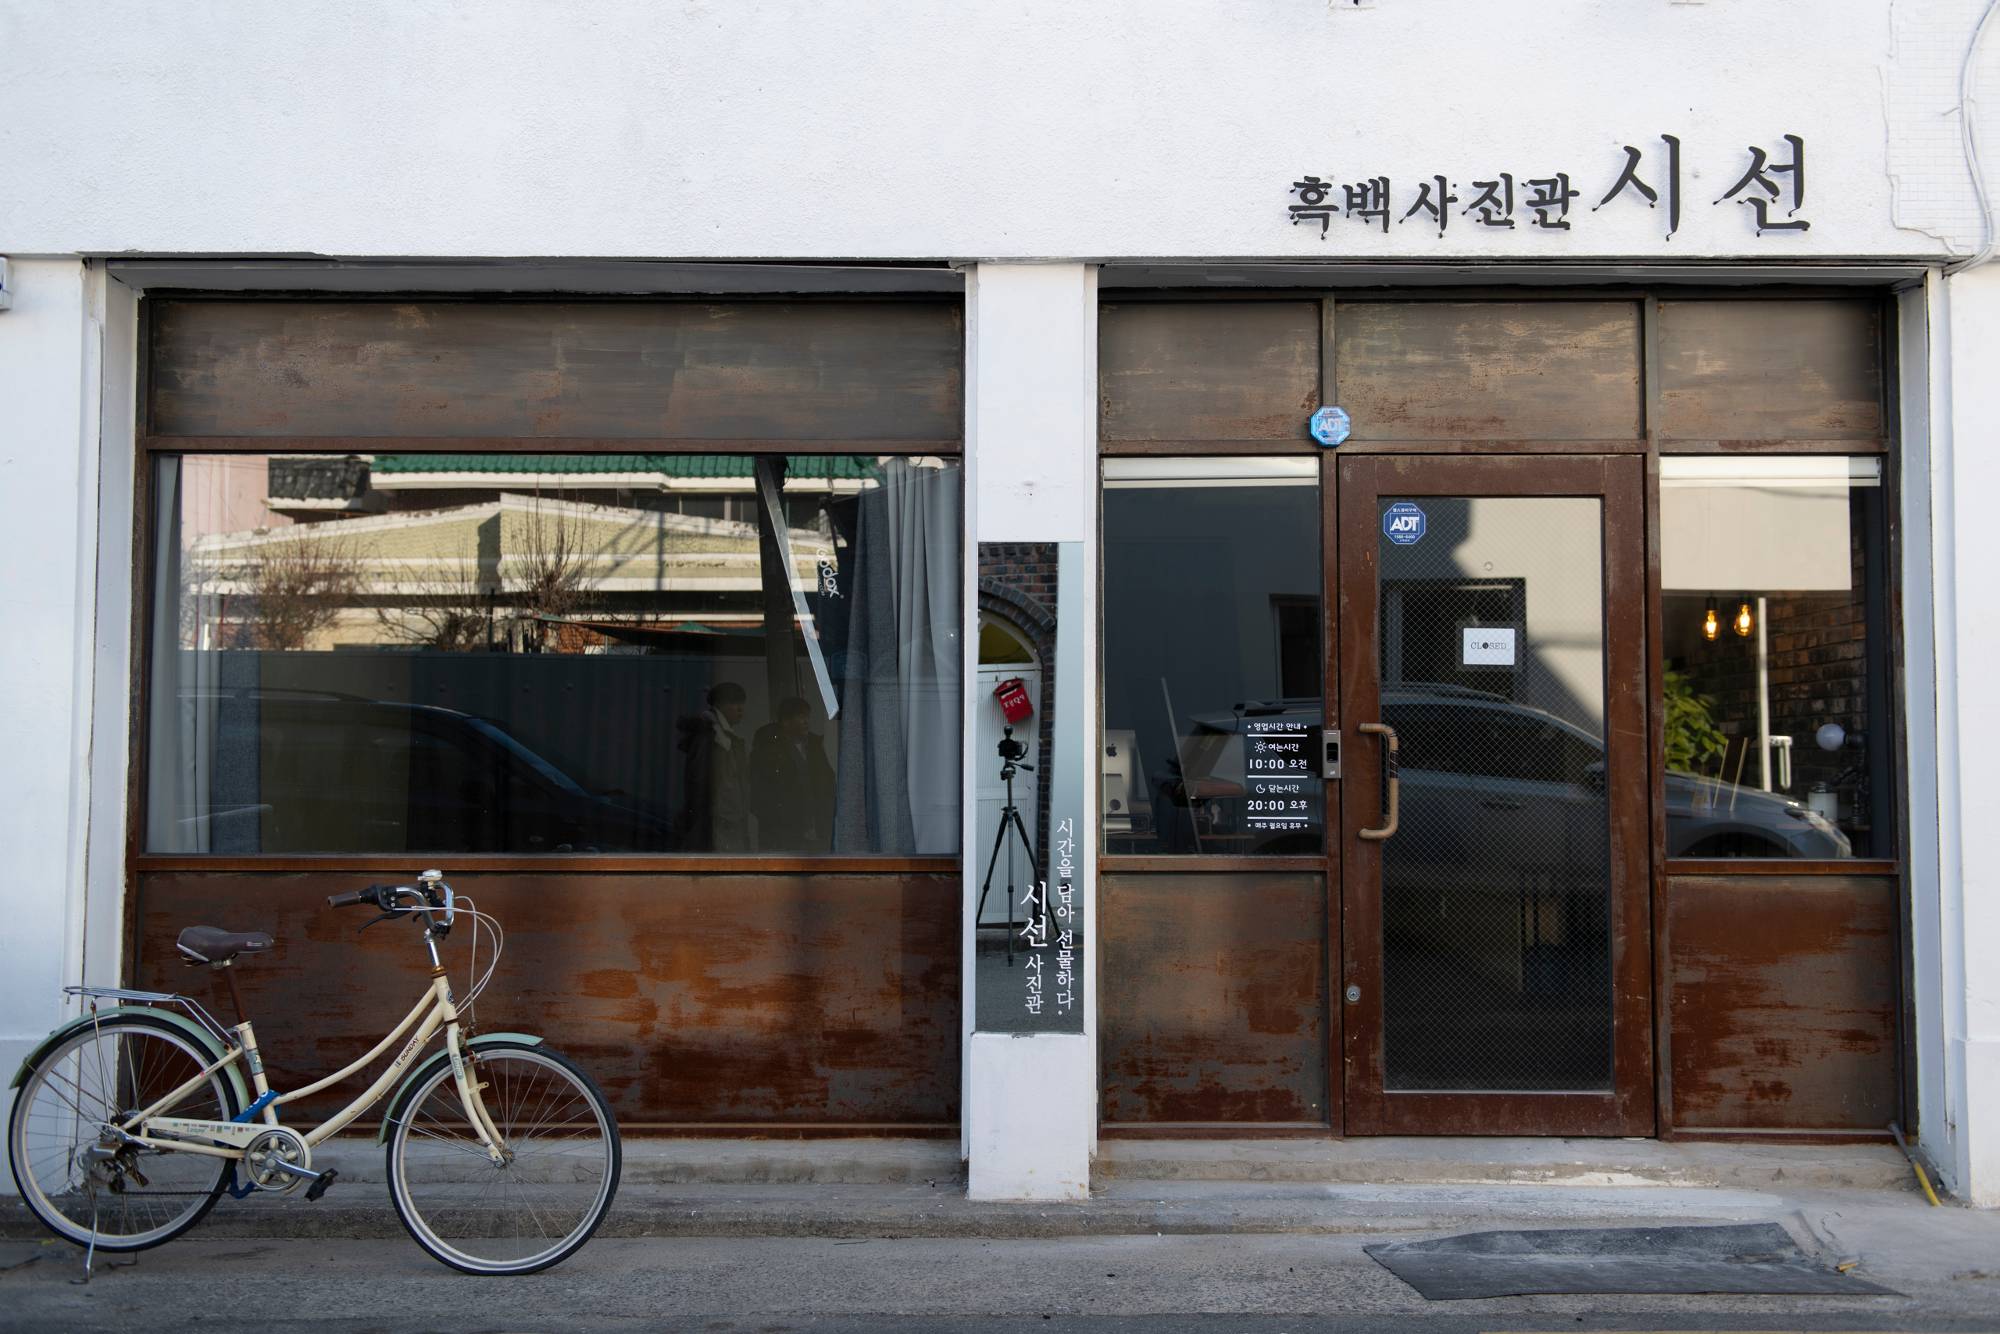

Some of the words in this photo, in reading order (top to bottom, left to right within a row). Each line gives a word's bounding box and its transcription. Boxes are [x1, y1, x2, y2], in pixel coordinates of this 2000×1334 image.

[1390, 517, 1420, 531] ADT
[816, 549, 840, 598] Godox
[1470, 641, 1507, 650] CLOSED
[1254, 722, 1284, 731] 영업시간
[1286, 722, 1301, 731] 안내
[1268, 743, 1299, 752] 여는시간
[1249, 759, 1285, 769] 10:00
[1289, 759, 1307, 769] 오전
[1268, 784, 1299, 793] 닫는시간
[1247, 800, 1285, 810] 20:00
[1290, 800, 1308, 810] 오후
[1056, 818, 1075, 878] 시간을
[1056, 883, 1075, 923] 담아
[1019, 880, 1048, 948] 시선
[1055, 929, 1075, 1016] 선물하다.
[1024, 954, 1044, 1015] 사진관
